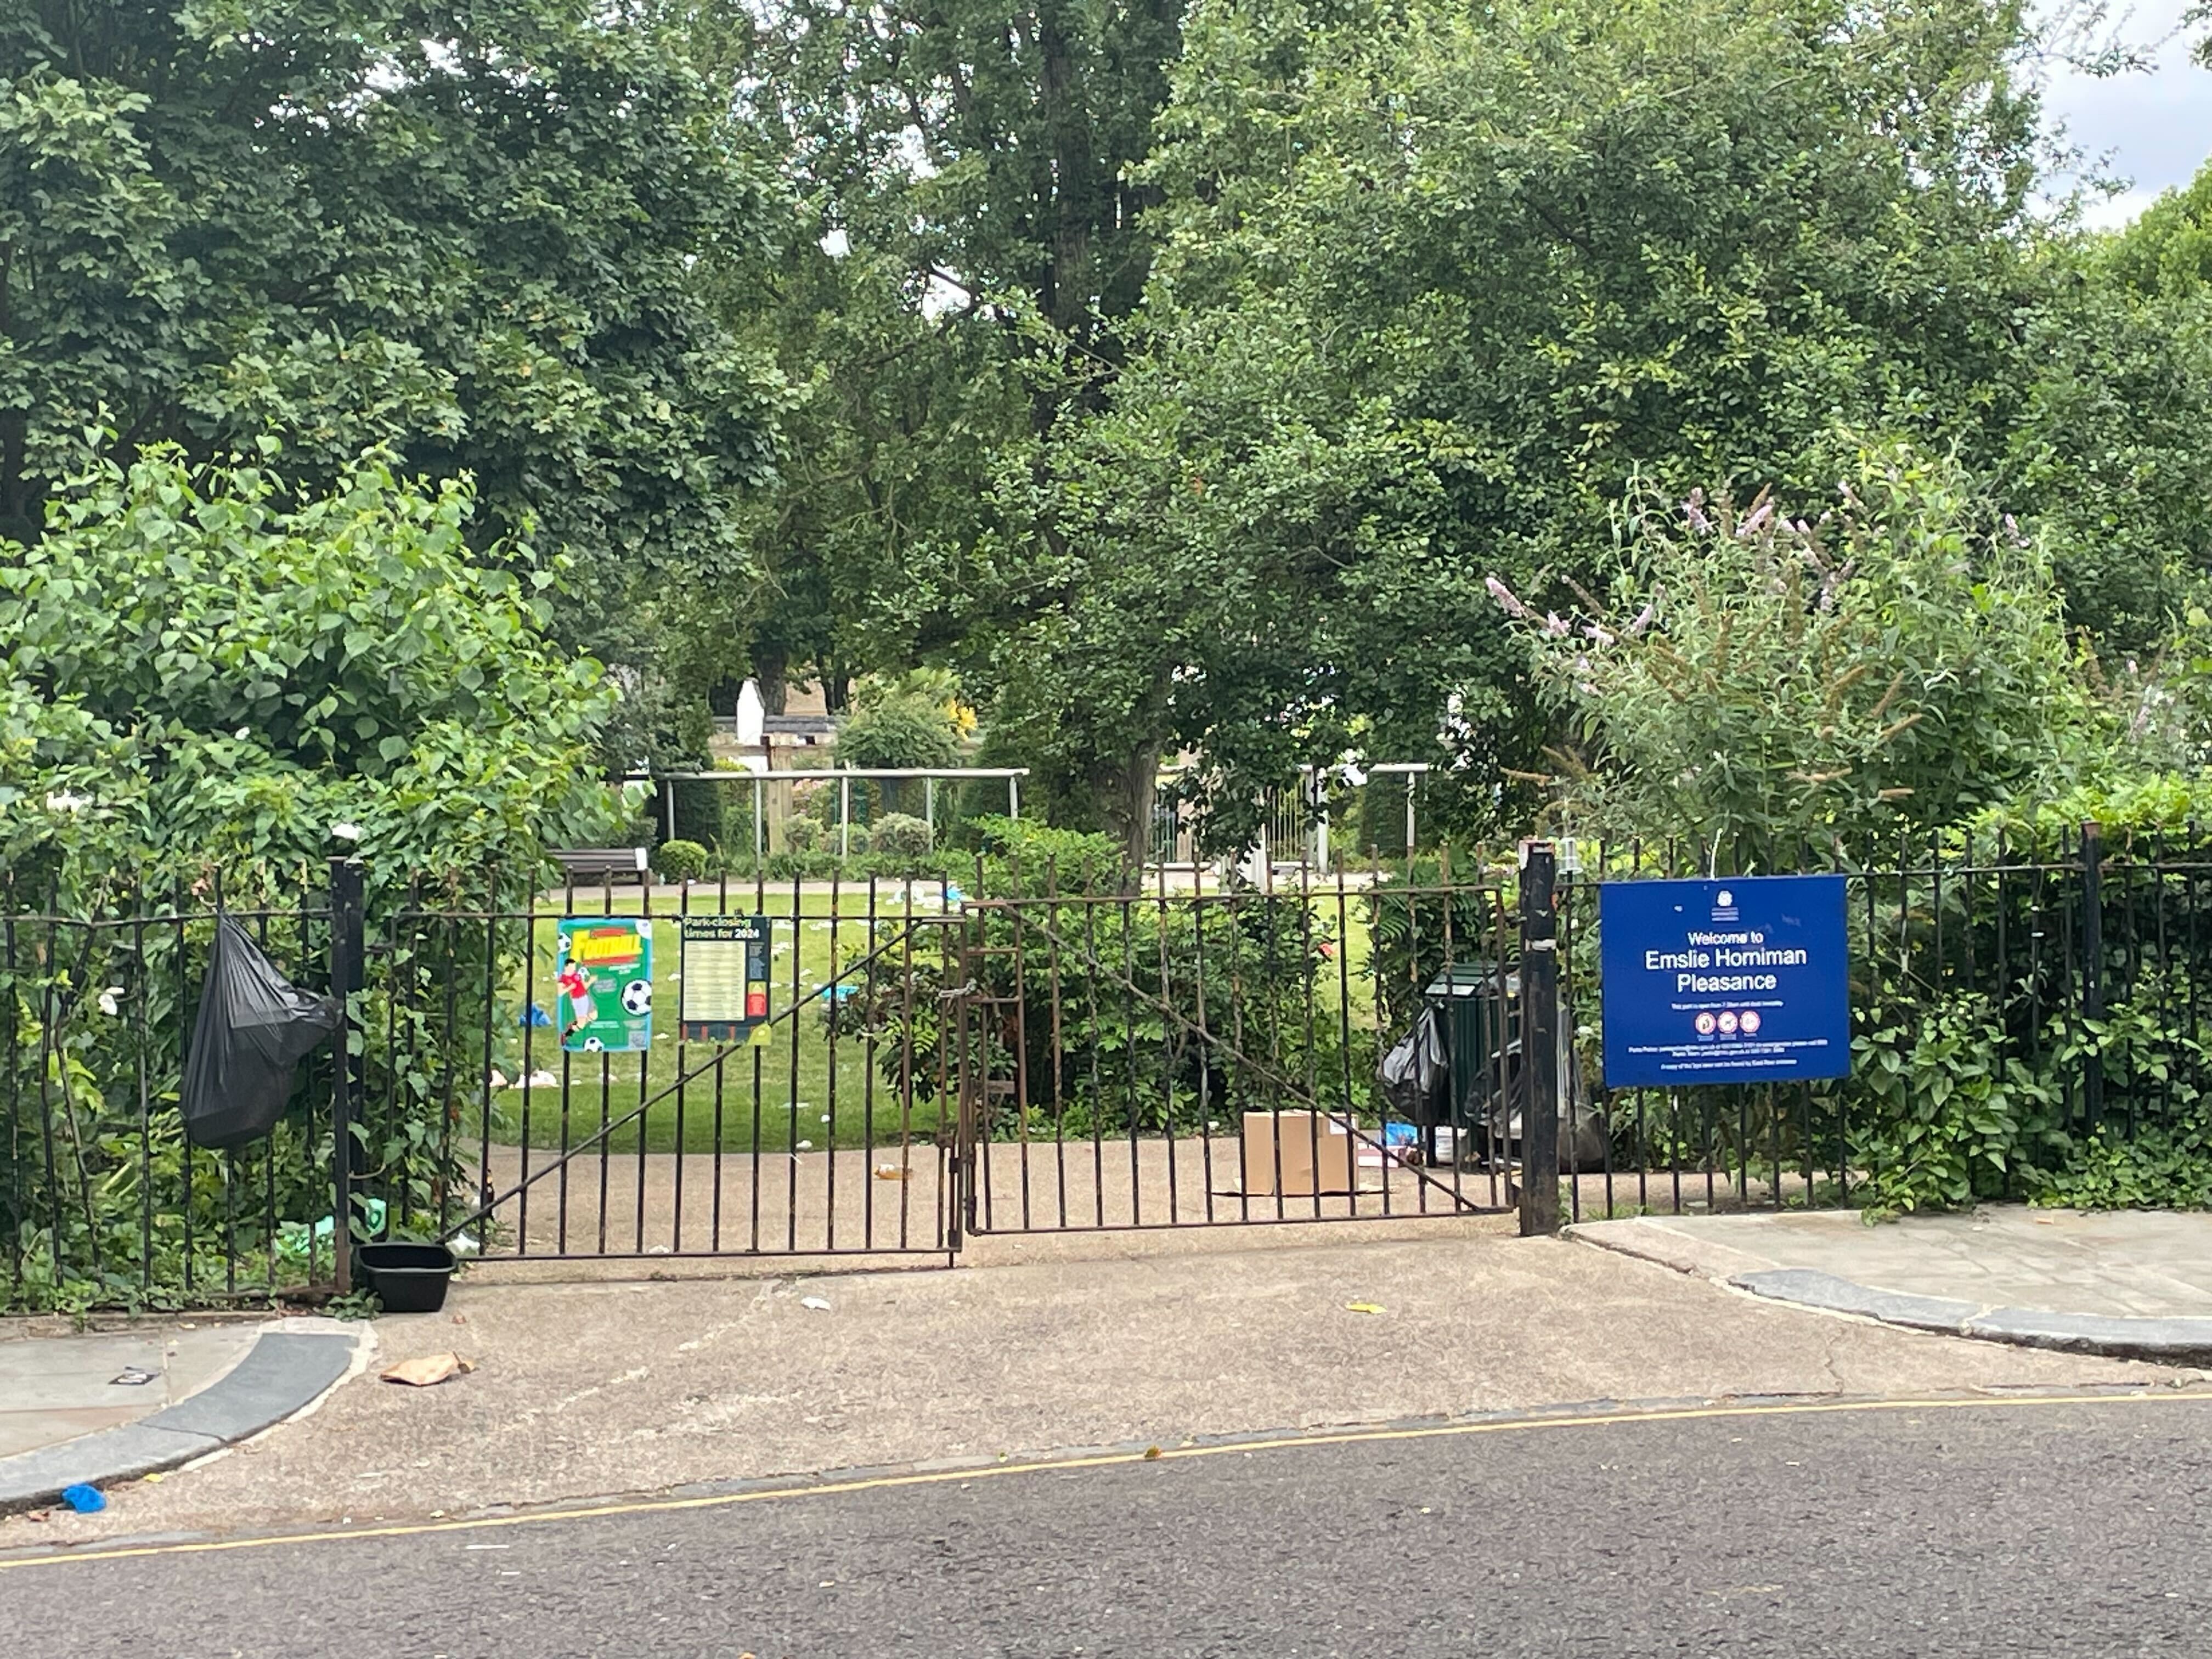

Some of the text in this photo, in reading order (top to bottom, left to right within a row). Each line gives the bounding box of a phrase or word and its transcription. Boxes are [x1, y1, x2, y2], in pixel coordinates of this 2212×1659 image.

[685, 928, 759, 939] times for 2024
[1687, 931, 1764, 946] Welcome to
[1645, 949, 1710, 970] Emslie
[1678, 973, 1777, 993] Pleasance
